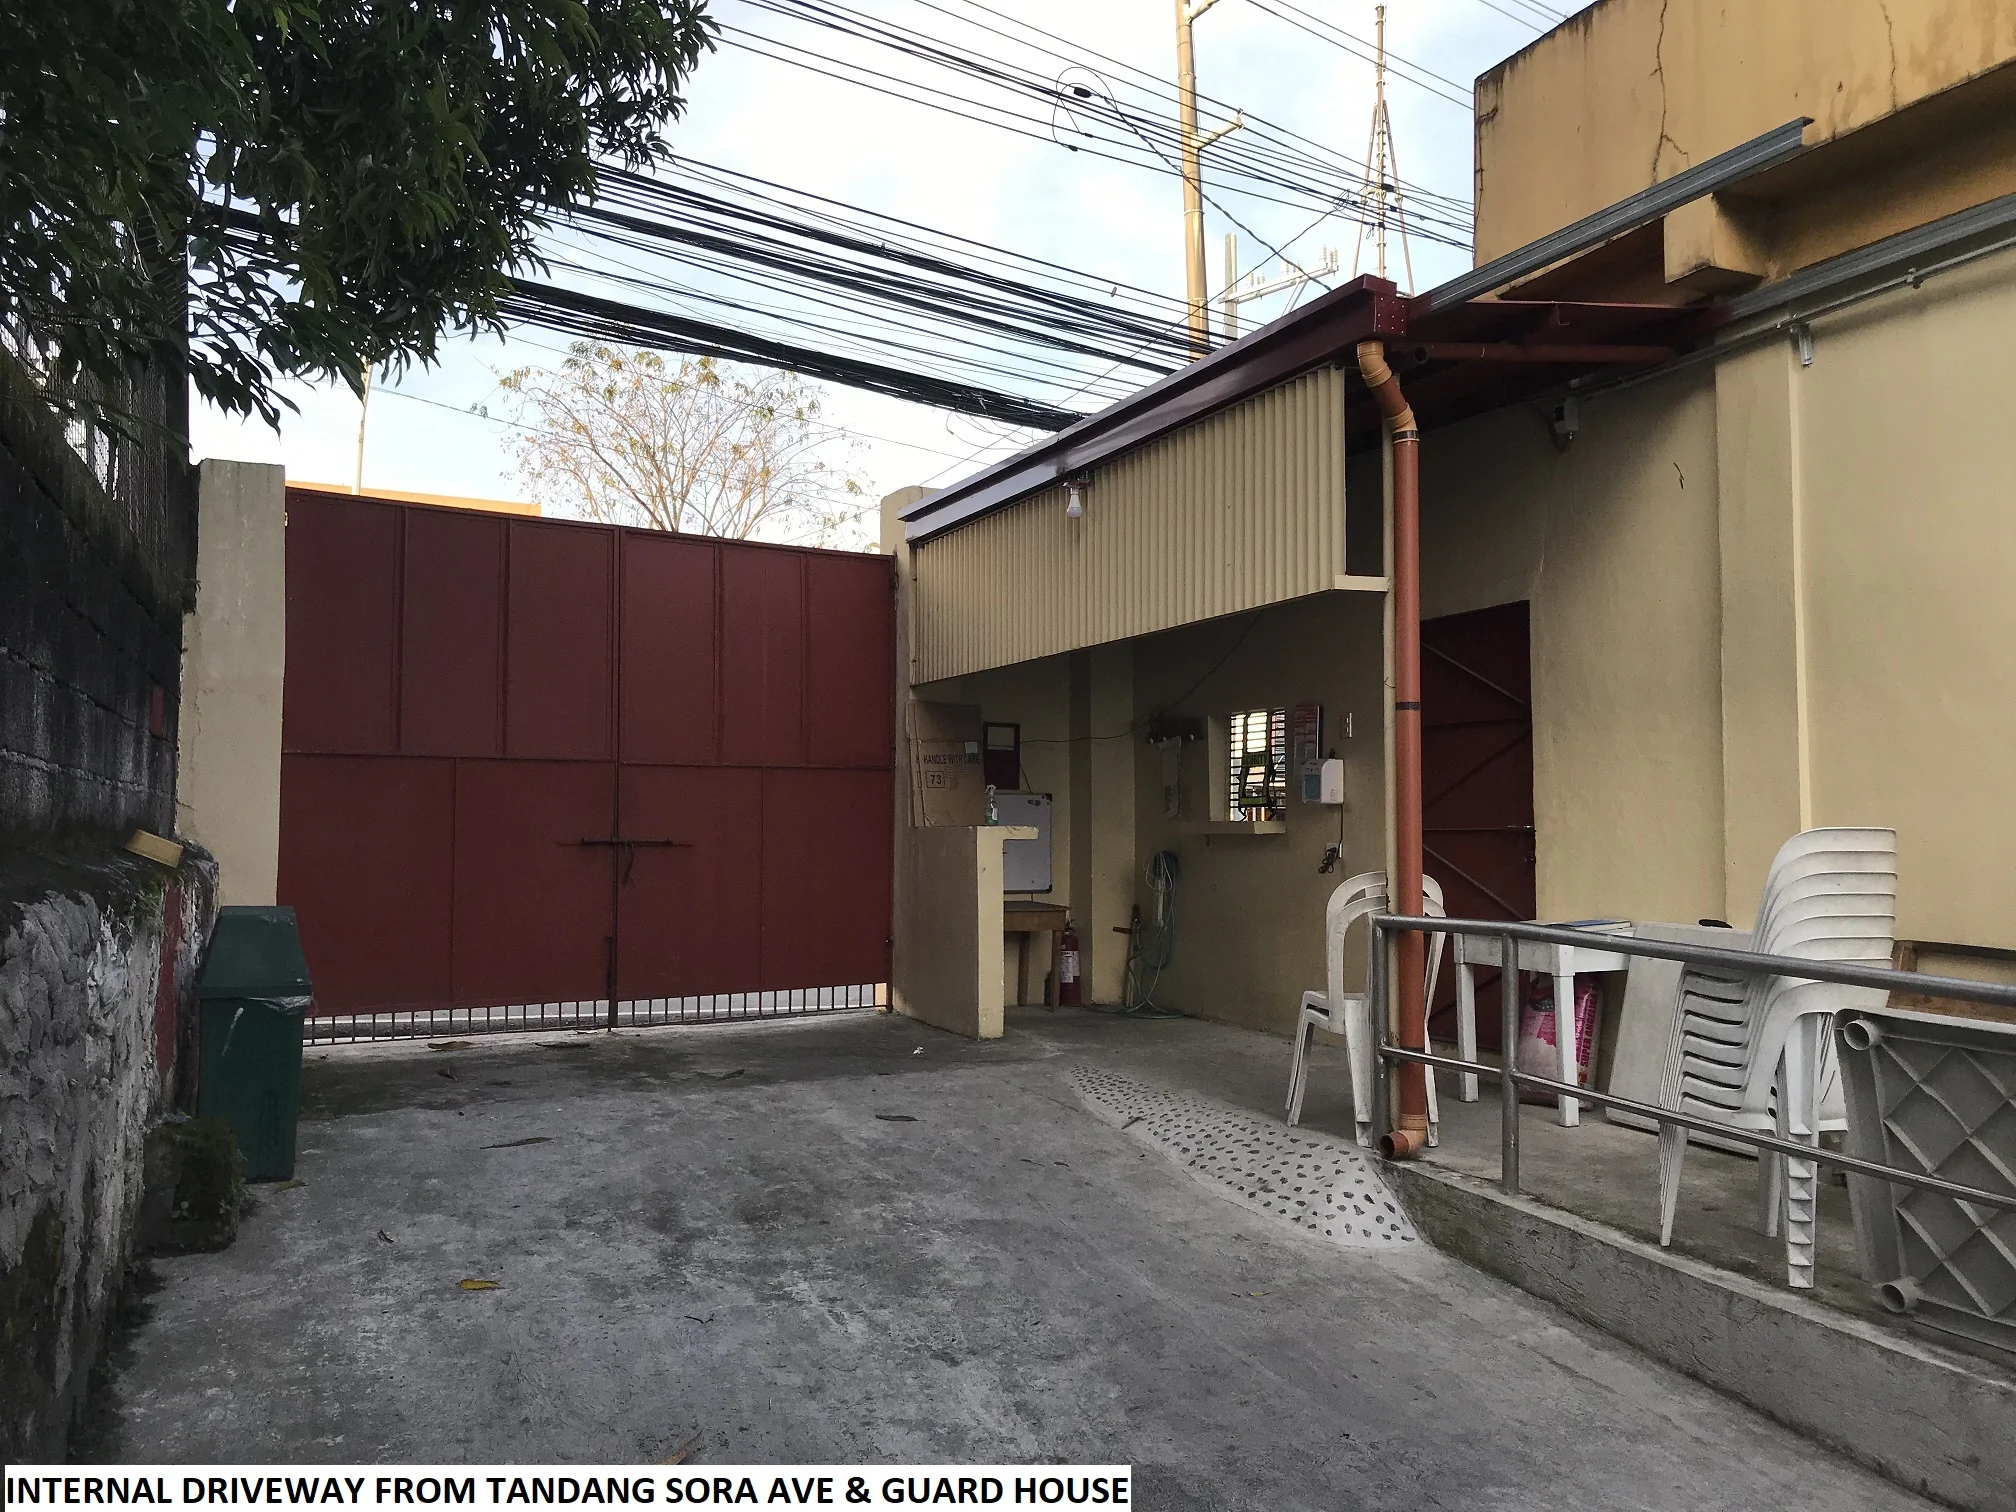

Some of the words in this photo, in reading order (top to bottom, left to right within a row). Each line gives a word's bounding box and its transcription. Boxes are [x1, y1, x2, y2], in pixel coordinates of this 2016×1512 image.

[924, 754, 947, 765] HANDLE
[948, 754, 963, 765] WITH
[964, 754, 980, 765] CARE
[930, 774, 942, 785] 73
[1580, 1037, 1592, 1067] SUPER
